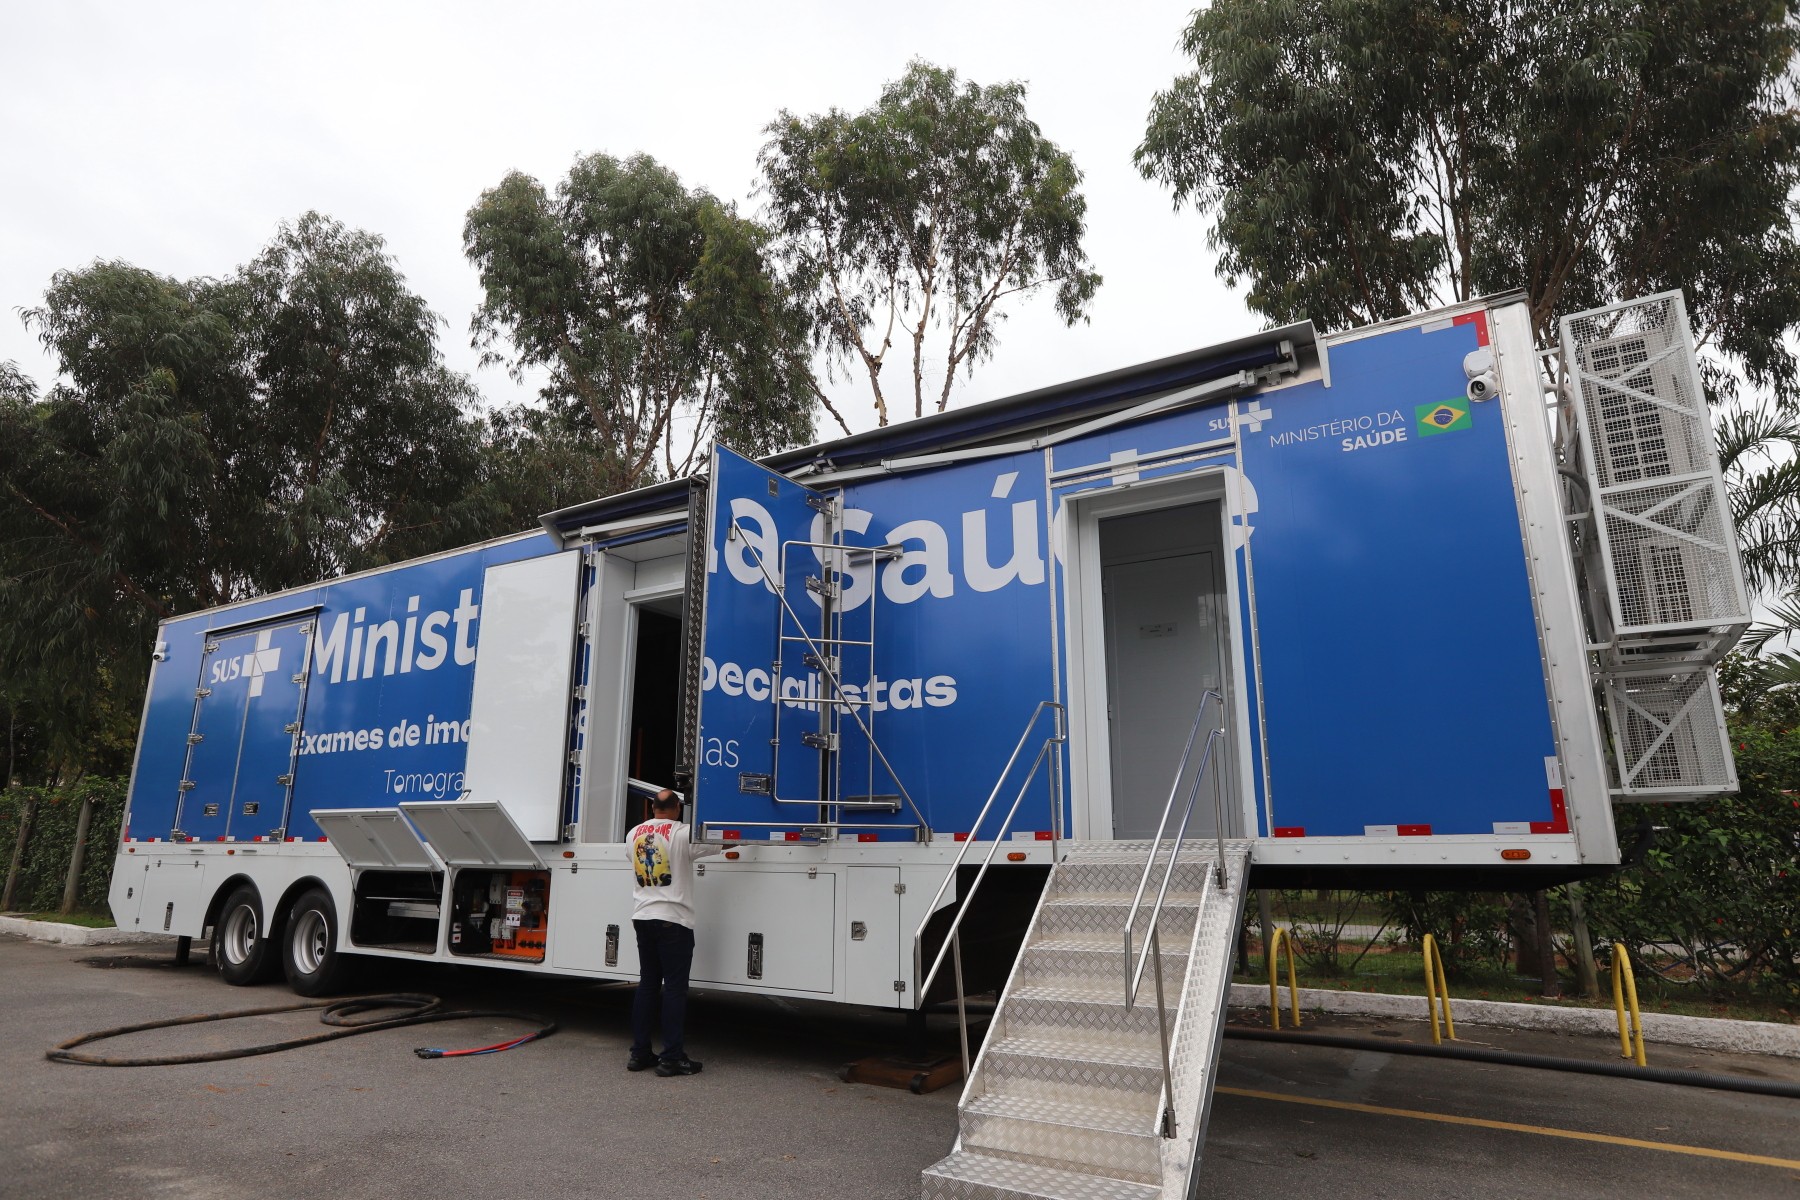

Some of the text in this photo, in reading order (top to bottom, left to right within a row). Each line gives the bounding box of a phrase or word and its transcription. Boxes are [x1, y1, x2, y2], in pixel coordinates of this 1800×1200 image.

[1208, 417, 1231, 432] SU
[1270, 409, 1405, 448] MINISTÉRIO DA
[1341, 427, 1408, 452] SAÚDE
[210, 655, 241, 684] SUS
[290, 728, 384, 757] Exames
[388, 719, 421, 748] de
